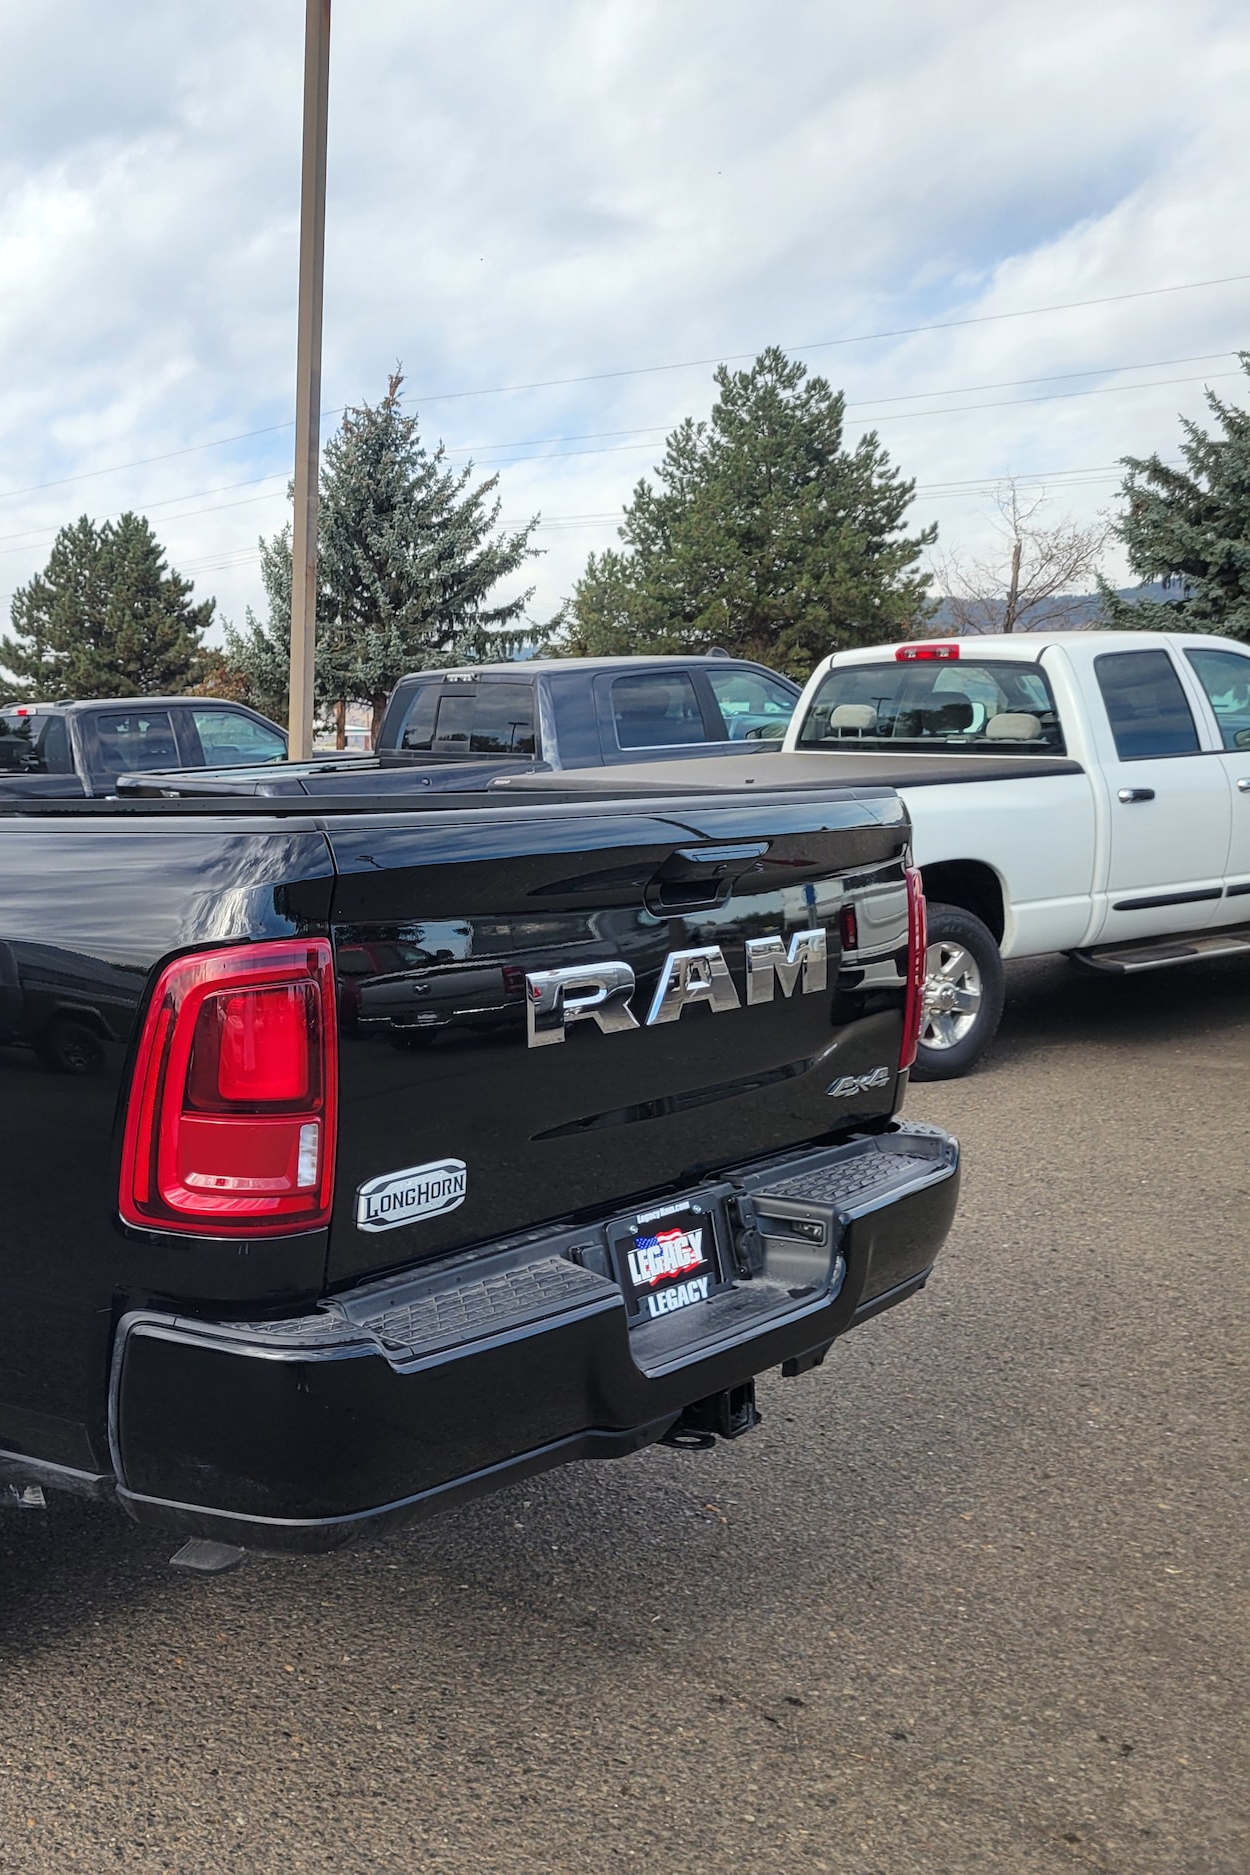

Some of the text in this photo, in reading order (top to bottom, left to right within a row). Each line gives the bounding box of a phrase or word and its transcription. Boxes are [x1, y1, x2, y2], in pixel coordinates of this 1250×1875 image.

[525, 928, 827, 1048] RAM
[365, 1174, 465, 1220] LONGHORN
[627, 1231, 704, 1285] LEGACY
[648, 1277, 708, 1318] LEGACY
